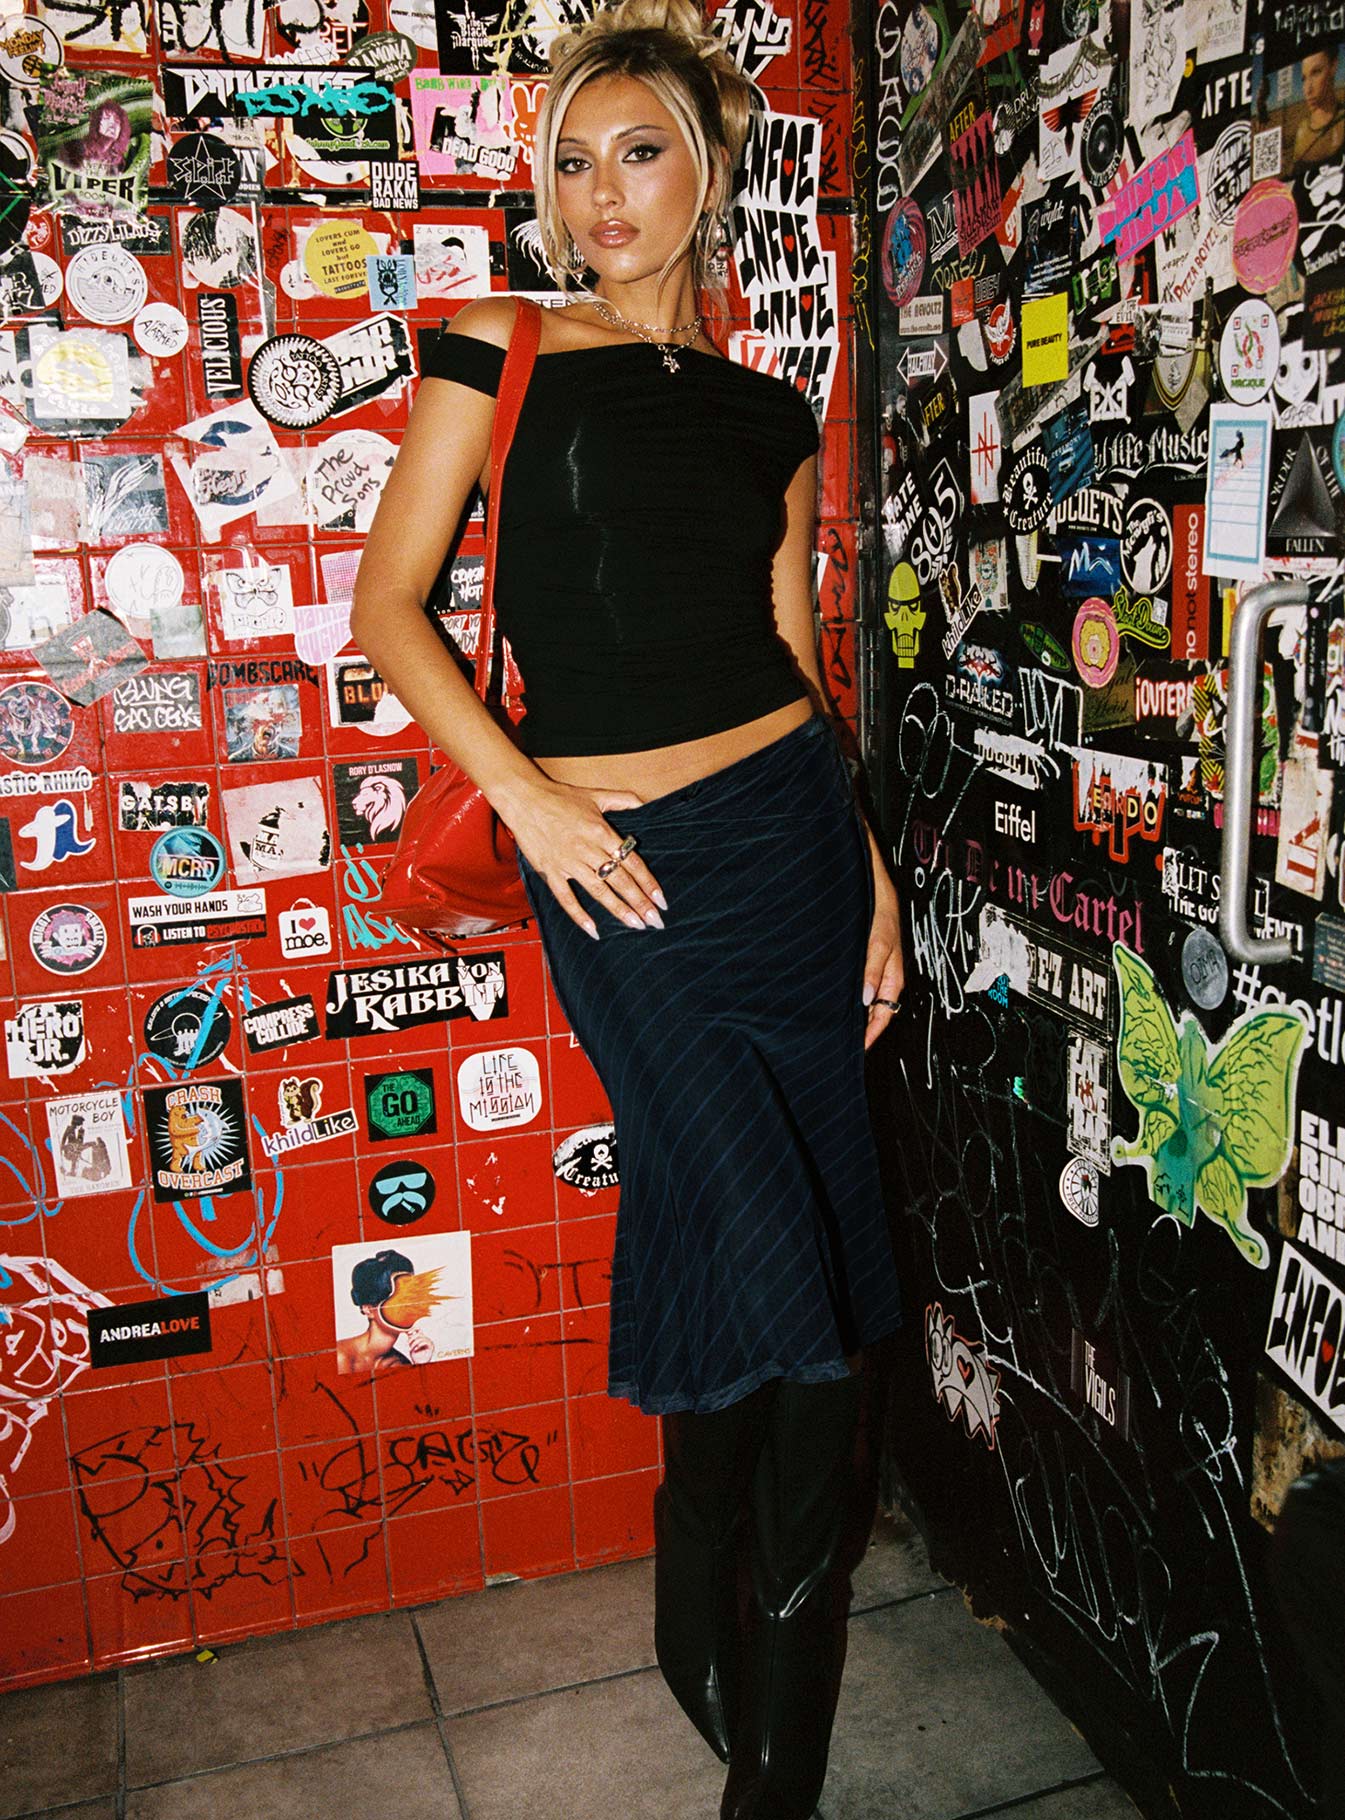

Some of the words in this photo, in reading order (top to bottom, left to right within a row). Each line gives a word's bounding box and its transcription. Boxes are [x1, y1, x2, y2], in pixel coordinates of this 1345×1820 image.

[1202, 68, 1253, 119] AFTE
[441, 136, 477, 162] DEAD
[479, 146, 517, 173] GOOD
[51, 162, 136, 203] VIPER
[372, 162, 416, 180] DUDE
[372, 180, 417, 198] RAKM
[373, 198, 397, 209] BAD
[400, 199, 418, 209] NEWS
[322, 259, 367, 276] TATTOOS
[341, 271, 366, 281] FOREVE
[1026, 338, 1040, 349] PURE
[1040, 333, 1062, 347] BEAUTY
[291, 353, 322, 368] TATTOO
[315, 448, 354, 482] The
[1002, 446, 1049, 504] Beautifu
[341, 477, 381, 507] Sons
[1286, 538, 1325, 553] FALLEN
[343, 683, 388, 704] BLO
[349, 766, 367, 776] RORY
[120, 795, 209, 818] GATSBY
[995, 801, 1035, 843] Eiffel
[132, 905, 162, 918] WASH
[165, 903, 193, 916] YOUR
[194, 900, 228, 914] HANDS
[1050, 871, 1144, 953] Cartel
[163, 927, 192, 940] LISTEN
[193, 926, 206, 938] TO
[291, 919, 297, 934] I
[285, 933, 329, 951] moe.
[326, 962, 449, 1015] JESIKA
[456, 960, 501, 979] VON
[1069, 963, 1106, 1021] ART
[243, 1003, 315, 1035] COMPRESS
[256, 1020, 309, 1045] COLLIDE
[32, 1040, 69, 1063] JR.
[482, 1053, 518, 1076] LIFE
[166, 1086, 222, 1110] CRASH
[382, 1083, 396, 1093] THE
[49, 1096, 119, 1117] MOTORCYCLE
[382, 1090, 417, 1116] GO
[92, 1110, 116, 1124] BOY
[397, 1114, 421, 1127] AHEAD
[157, 1159, 245, 1189] OVERCAST
[564, 1168, 619, 1187] Creatu
[1084, 1340, 1095, 1369] THE
[1085, 1369, 1116, 1426] VIGILS
